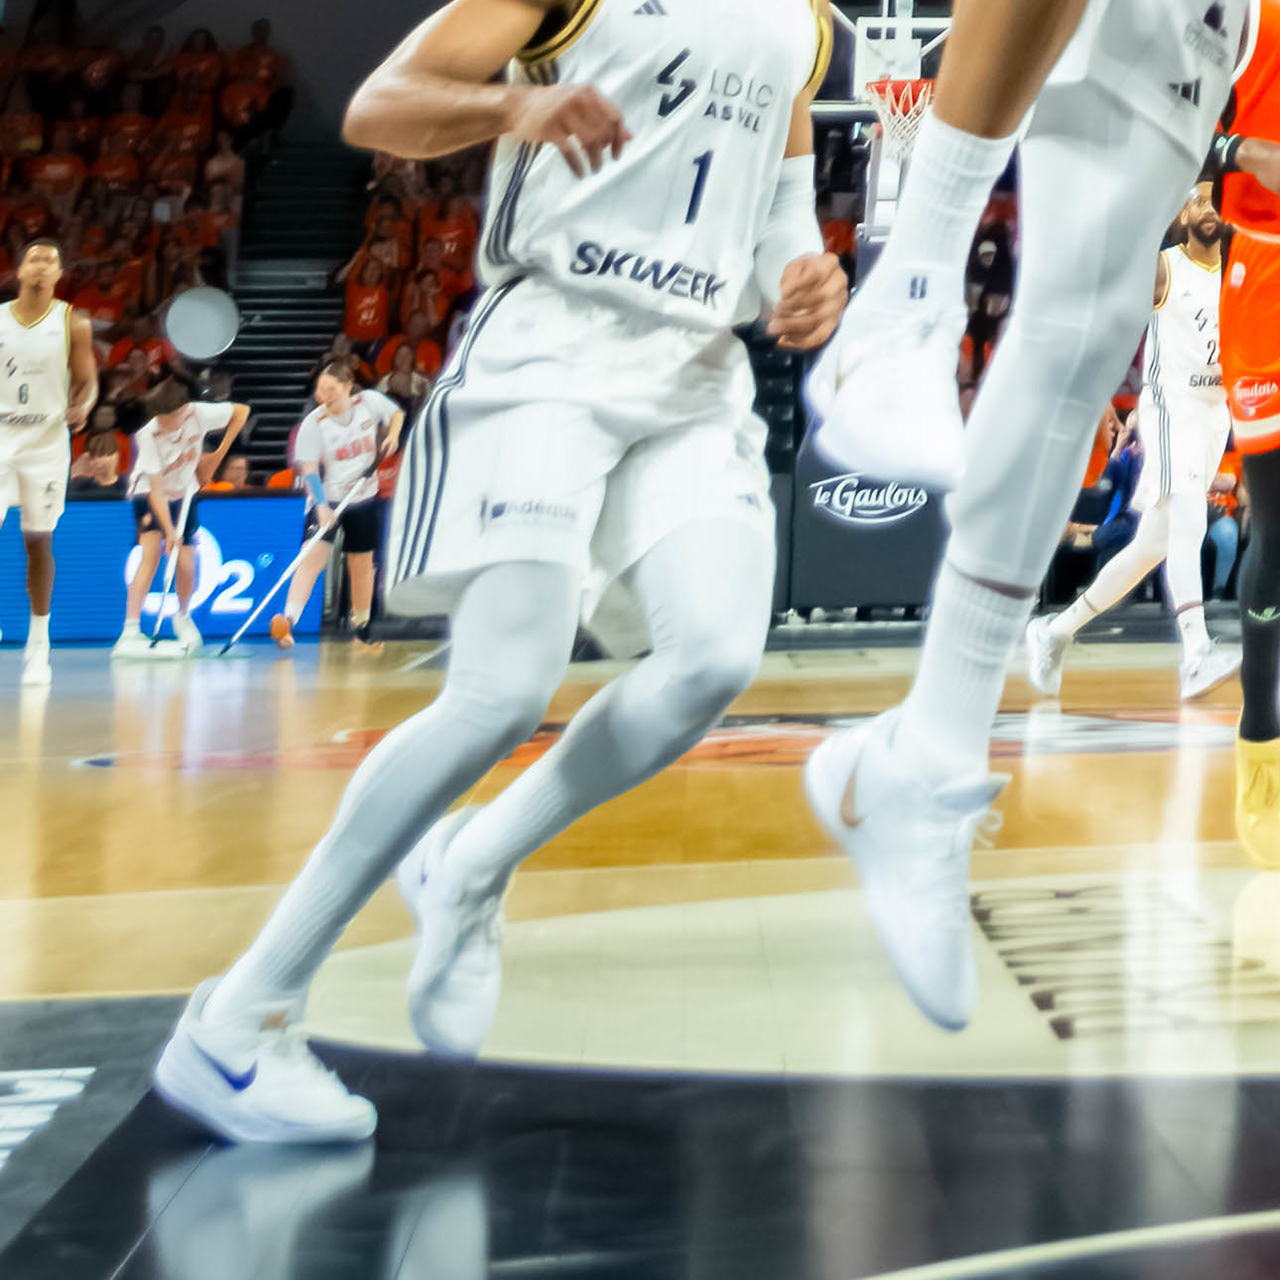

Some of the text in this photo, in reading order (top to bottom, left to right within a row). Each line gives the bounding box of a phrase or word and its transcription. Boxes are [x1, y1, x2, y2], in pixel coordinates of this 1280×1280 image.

[709, 68, 774, 109] LDLC
[703, 103, 761, 134] ASVEL
[684, 149, 712, 225] 1
[569, 241, 726, 309] SKWEEK
[832, 477, 929, 517] Gaulois
